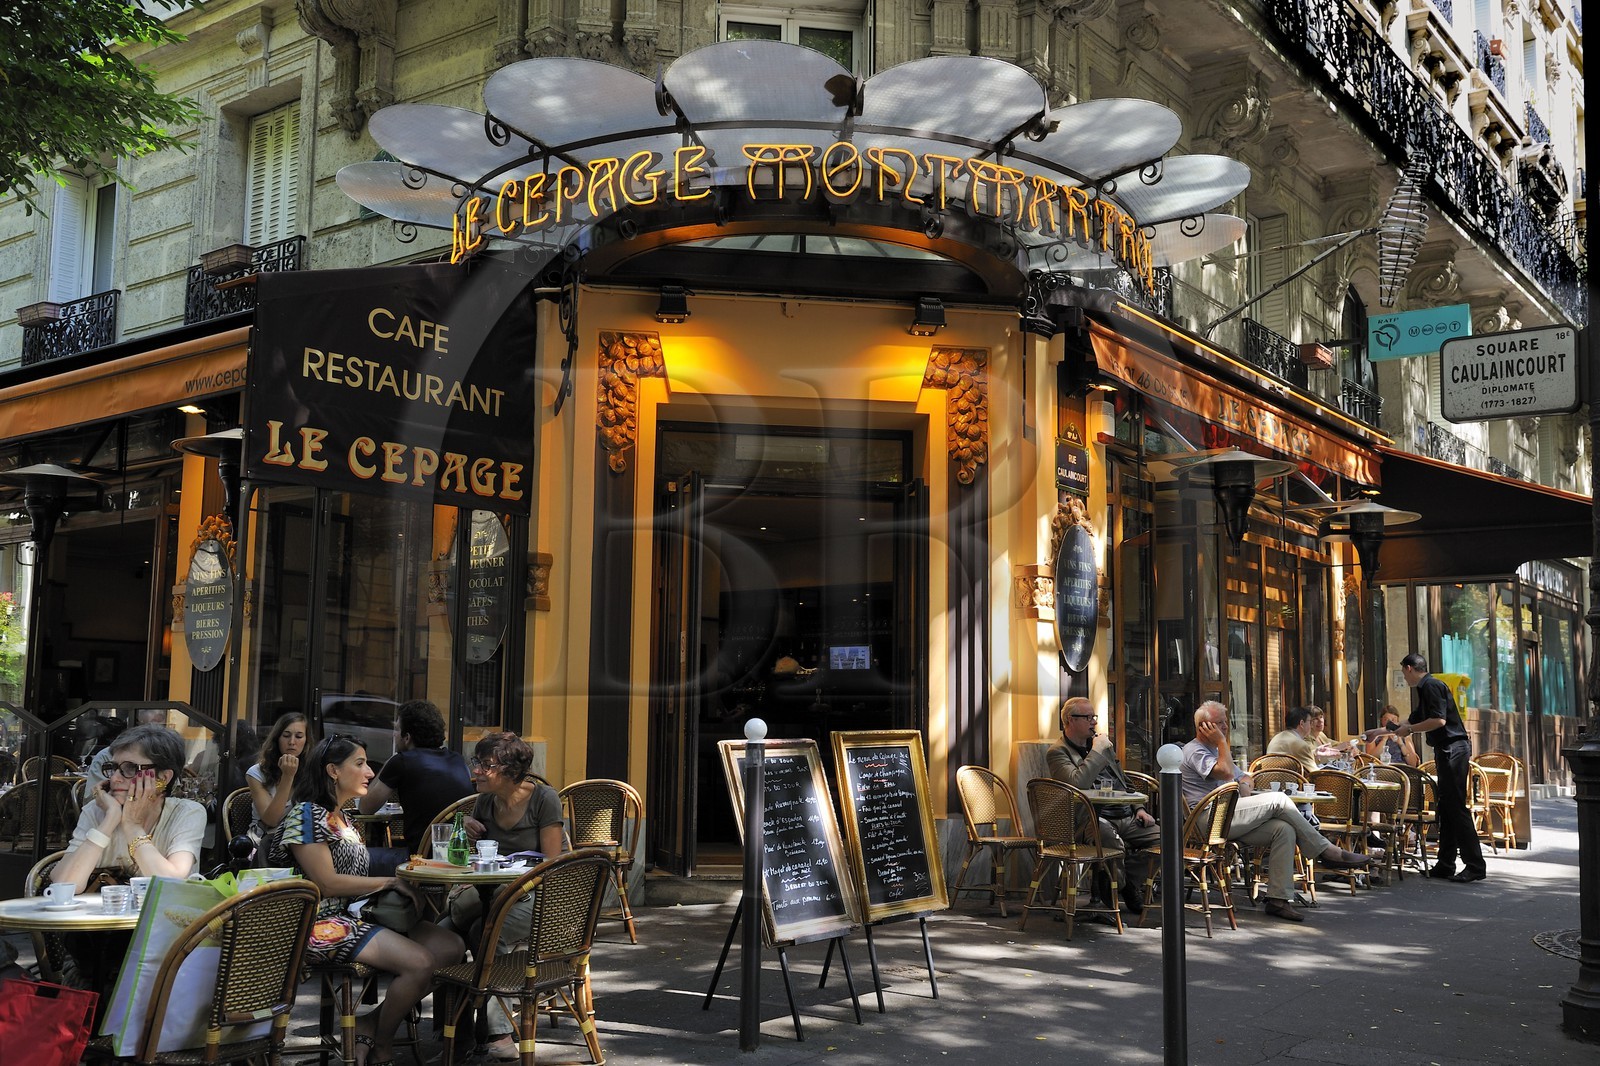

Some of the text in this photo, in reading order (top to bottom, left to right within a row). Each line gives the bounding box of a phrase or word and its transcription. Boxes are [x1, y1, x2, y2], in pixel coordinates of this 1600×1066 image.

[450, 196, 481, 264] LE
[496, 146, 711, 233] CEPAGE
[368, 307, 450, 354] CAFE
[1476, 338, 1539, 356] SQUARE
[1451, 354, 1566, 384] CAULAINCOURT
[302, 347, 505, 417] RESTAURANT
[1481, 382, 1535, 395] DIPLOMATE
[263, 420, 525, 500] LE CEPAGE
[1068, 453, 1077, 465] RUE
[1078, 561, 1092, 573] FINS
[192, 585, 226, 597] APERITIFS
[191, 601, 225, 614] LIQUEURS
[196, 617, 219, 629] BIERES
[191, 629, 224, 640] PRESSION
